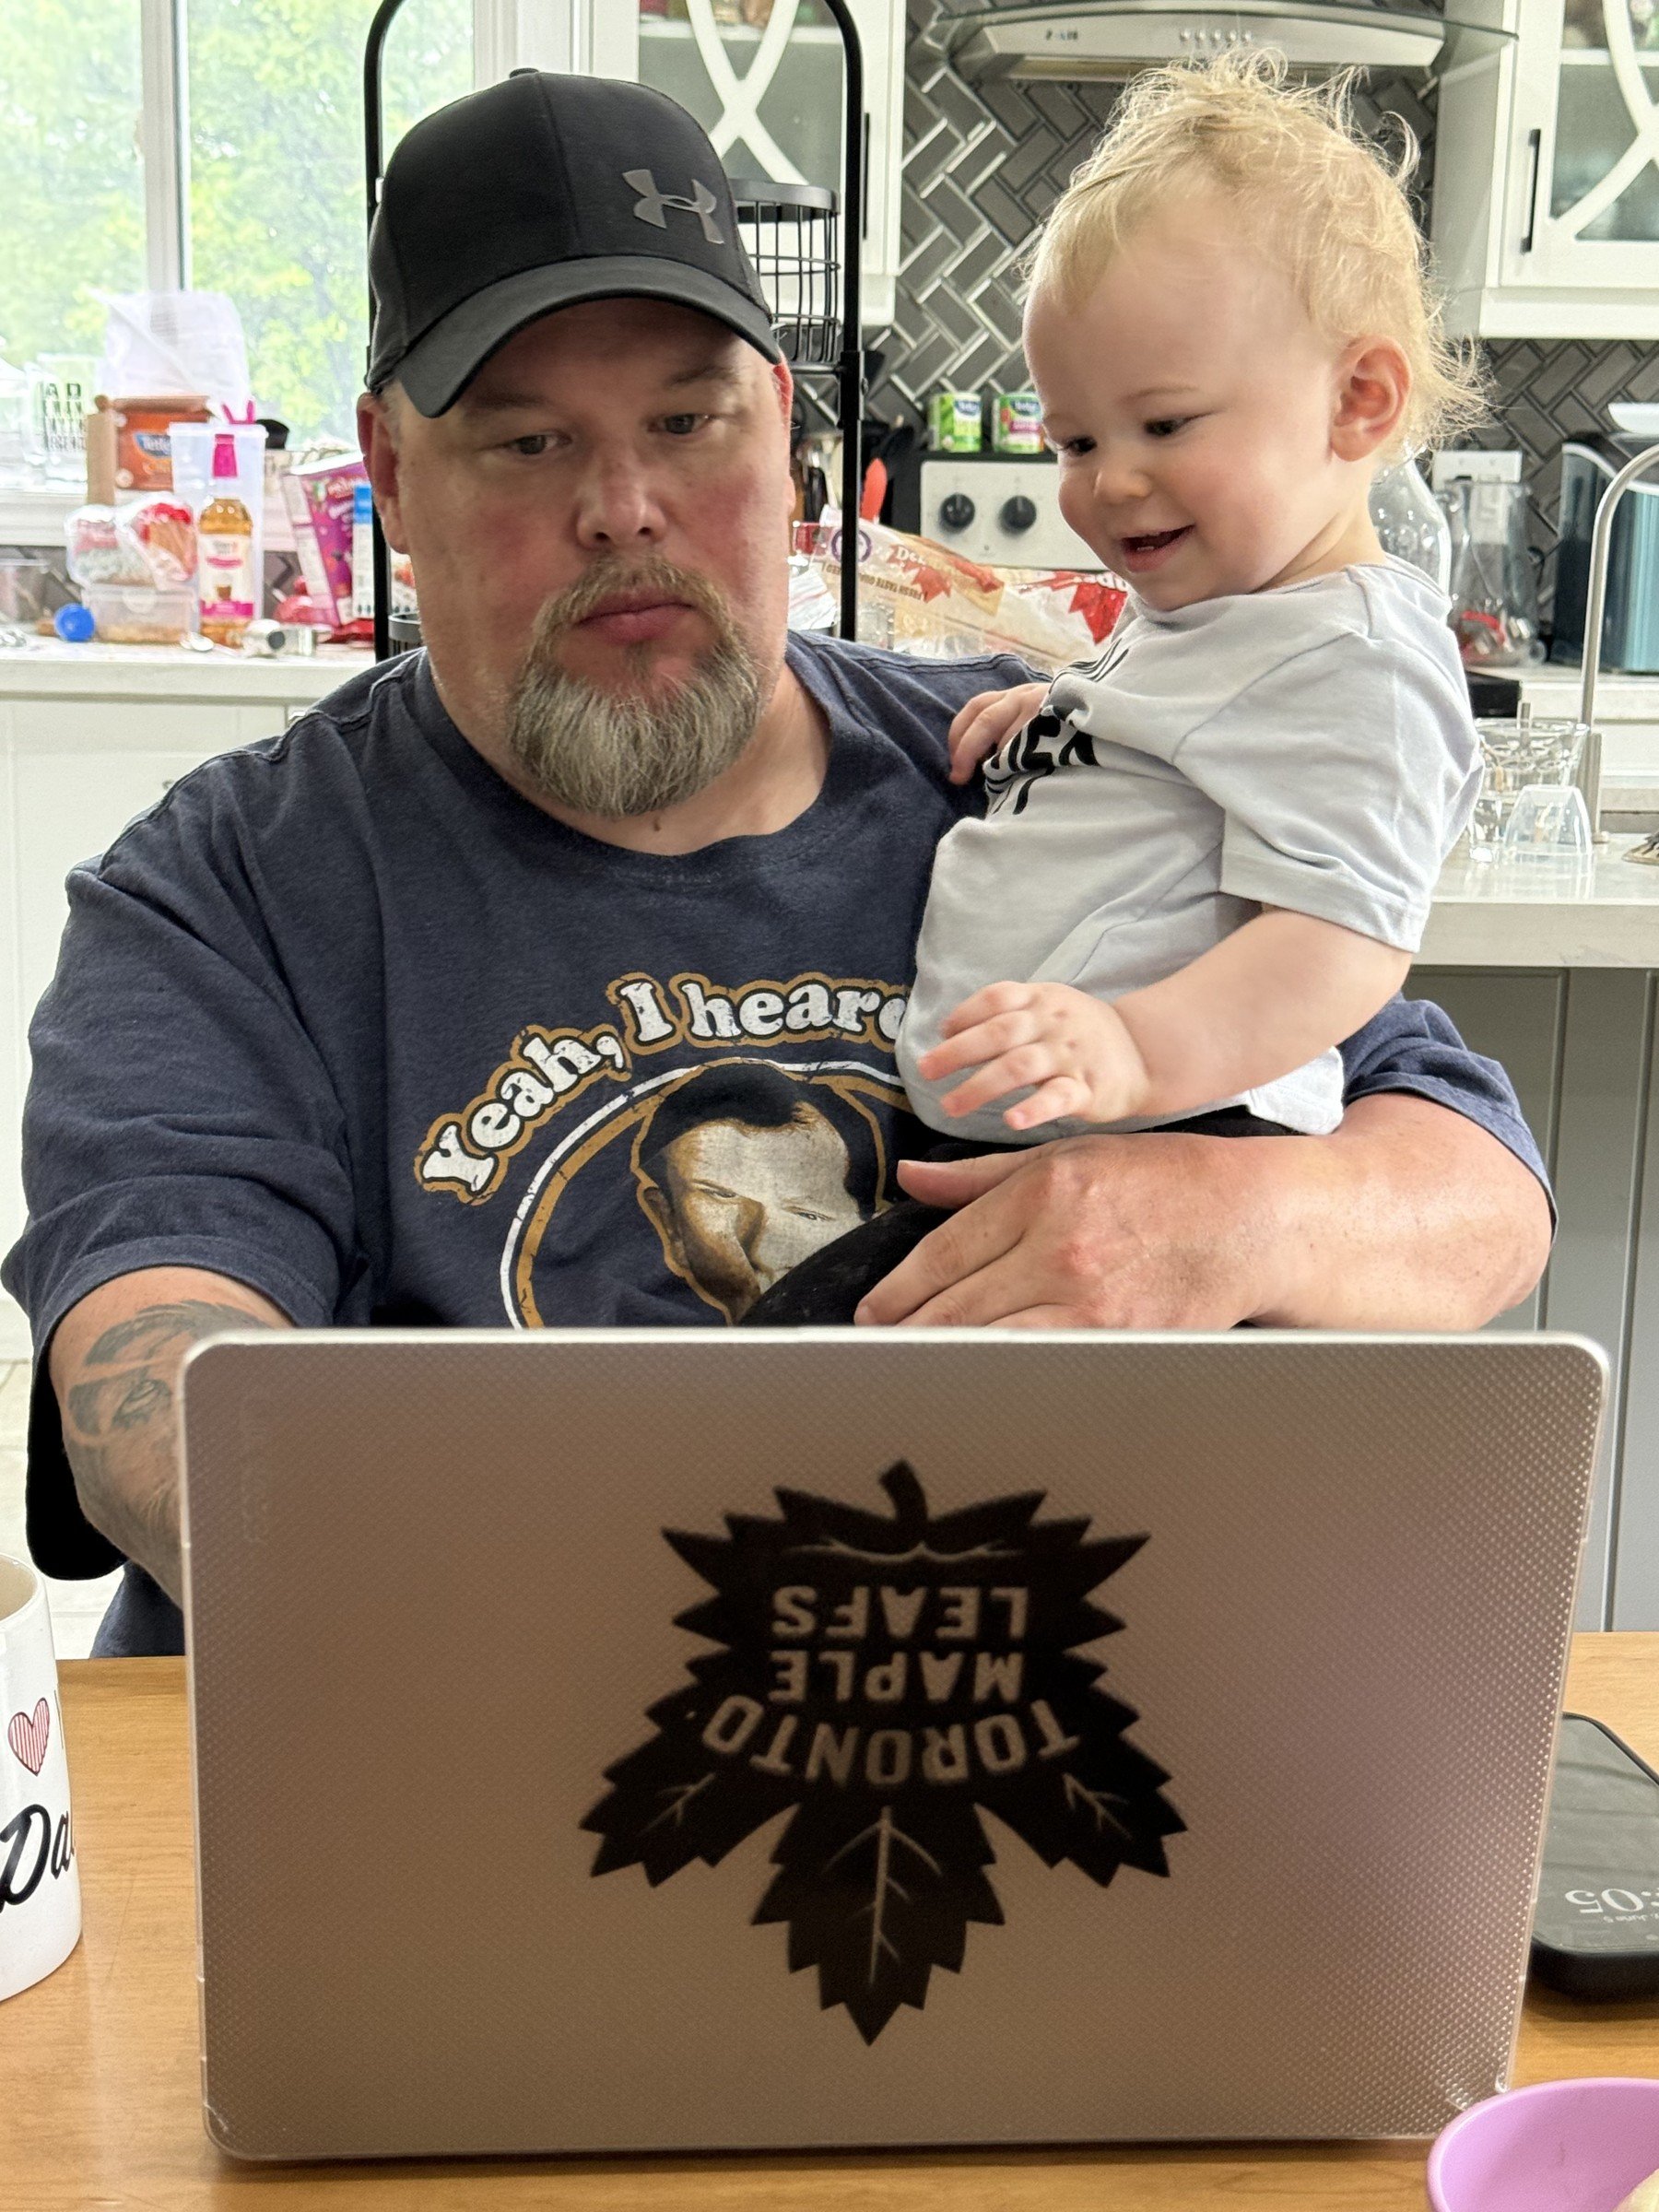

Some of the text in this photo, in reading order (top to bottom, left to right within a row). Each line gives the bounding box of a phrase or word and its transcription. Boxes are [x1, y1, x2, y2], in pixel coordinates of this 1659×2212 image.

[420, 1031, 627, 1195] Yeah,
[618, 979, 674, 1043] I
[772, 1585, 1030, 1640] LEAFS
[768, 1651, 1024, 1703] MAPLE
[701, 1695, 1079, 1784] TORONTO
[0, 1804, 75, 1914] Da
[1565, 1888, 1659, 1913] :05
